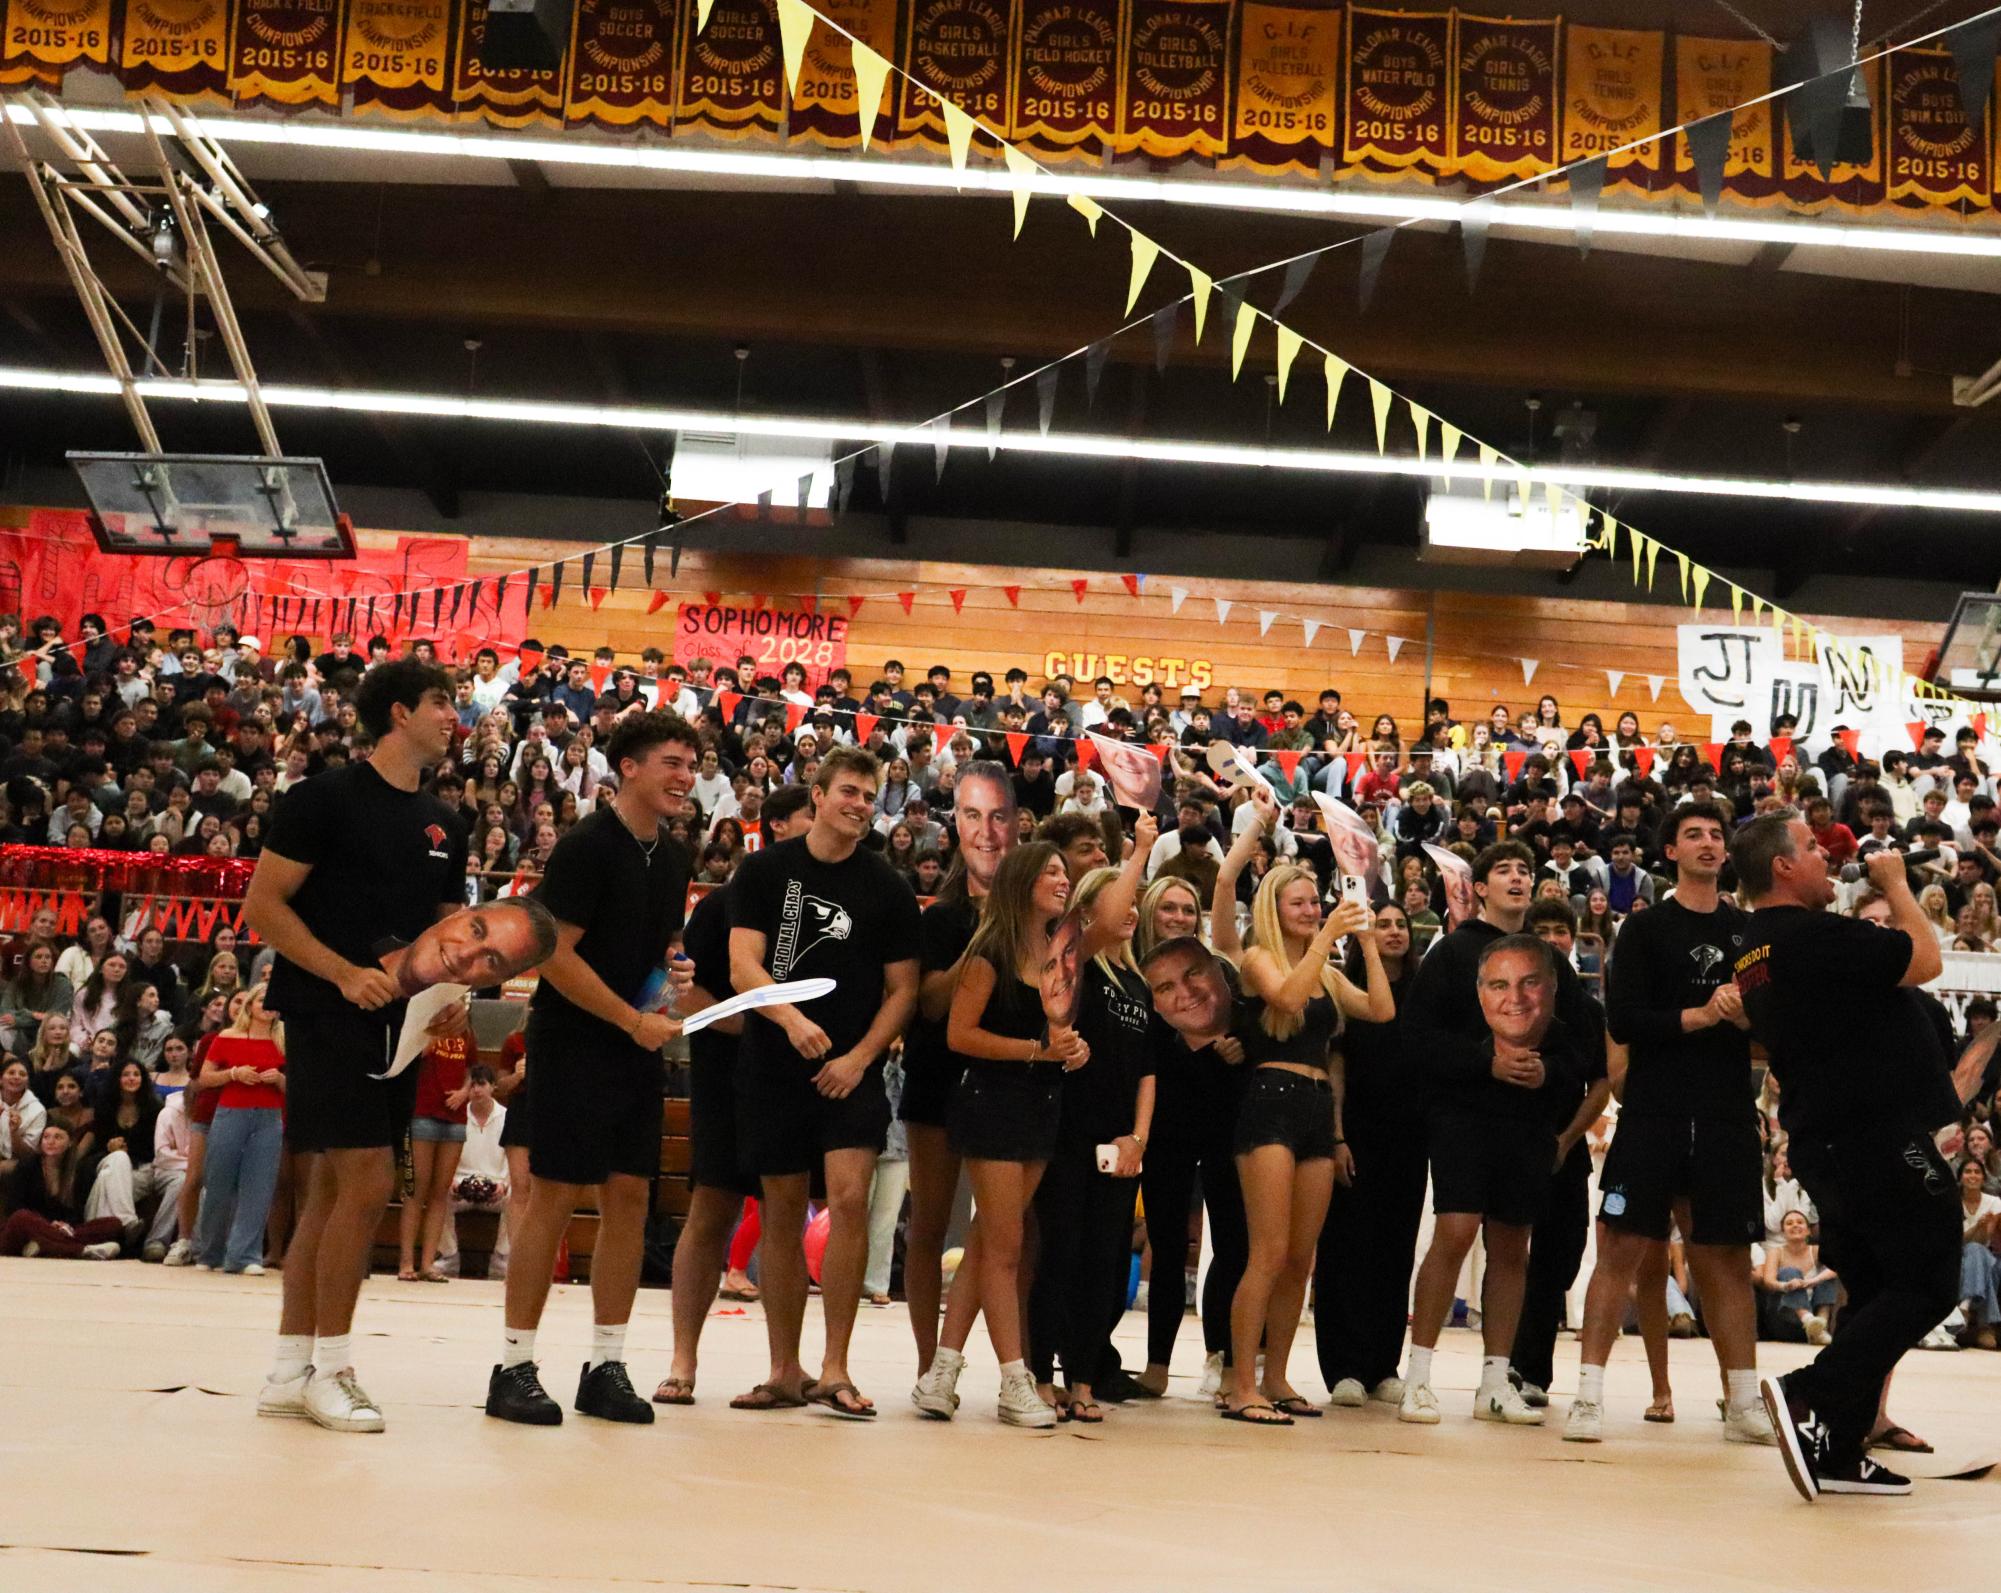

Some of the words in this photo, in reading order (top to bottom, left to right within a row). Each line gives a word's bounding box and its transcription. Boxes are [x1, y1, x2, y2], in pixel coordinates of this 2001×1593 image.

[247, 13, 329, 47] CHAMPIONSHIP
[357, 19, 439, 51] CHAMPIONSHIP
[600, 23, 653, 37] SOCCER
[710, 26, 764, 40] SOCCER
[939, 25, 981, 40] GIRLS
[1025, 6, 1071, 43] PALOMAR
[1077, 8, 1115, 44] LEAGUE
[1134, 14, 1182, 48] PALOMAR
[1185, 15, 1223, 50] LEAGUE
[13, 27, 99, 47] 2015-16
[132, 38, 217, 56] 2015-16
[919, 39, 1000, 56] BASKETBALL
[1049, 35, 1090, 47] GIRLS
[1159, 37, 1198, 52] GIRLS
[242, 48, 329, 68] 2015-16
[583, 39, 663, 72] CHAMPIONSHIP
[1025, 48, 1060, 62] FIELD
[1064, 49, 1111, 63] HOCKEY
[1354, 28, 1400, 65] PALOMAR
[1406, 31, 1444, 68] LEAGUE
[1461, 36, 1508, 72] PALOMAR
[1511, 36, 1552, 75] LEAGUE
[352, 52, 438, 75] 2015-16
[695, 43, 776, 75] CHAMPIONSHIP
[1136, 52, 1217, 68] VOLLEYBALL
[1485, 60, 1527, 75] GIRLS
[918, 55, 999, 89] CHAMPIONSHIP
[1027, 65, 1108, 98] CHAMPIONSHIP
[1362, 69, 1400, 84] WATER
[1403, 71, 1435, 87] POLO
[580, 74, 665, 93] 2015-16
[691, 76, 775, 96] 2015-16
[803, 81, 857, 100] 2015-
[1135, 67, 1217, 100] CHAMPIONSHIP
[1246, 74, 1326, 109] CHAMPIONSHIP
[1483, 77, 1530, 92] TENNIS
[1025, 98, 1109, 119] 2015-16
[1132, 101, 1216, 122] 2015-16
[1356, 86, 1437, 121] CHAMPIONSHIP
[1464, 90, 1544, 124] CHAMPIONSHIP
[1244, 110, 1327, 130] 2015-16
[1574, 99, 1651, 132] CHAMPIONSHIP
[1355, 121, 1439, 142] 2015-16
[1464, 125, 1546, 146] 2015-16
[1899, 125, 1977, 158] CHAMPIONSHIP
[1898, 156, 1980, 180] 2015-16
[683, 606, 847, 643] SOPHOMORE
[684, 642, 721, 657] Class
[733, 640, 752, 657] of
[758, 637, 834, 667] 2028
[1044, 652, 1212, 690] GUESTS
[772, 921, 797, 981] CARDINAL
[1761, 944, 1771, 959] IT
